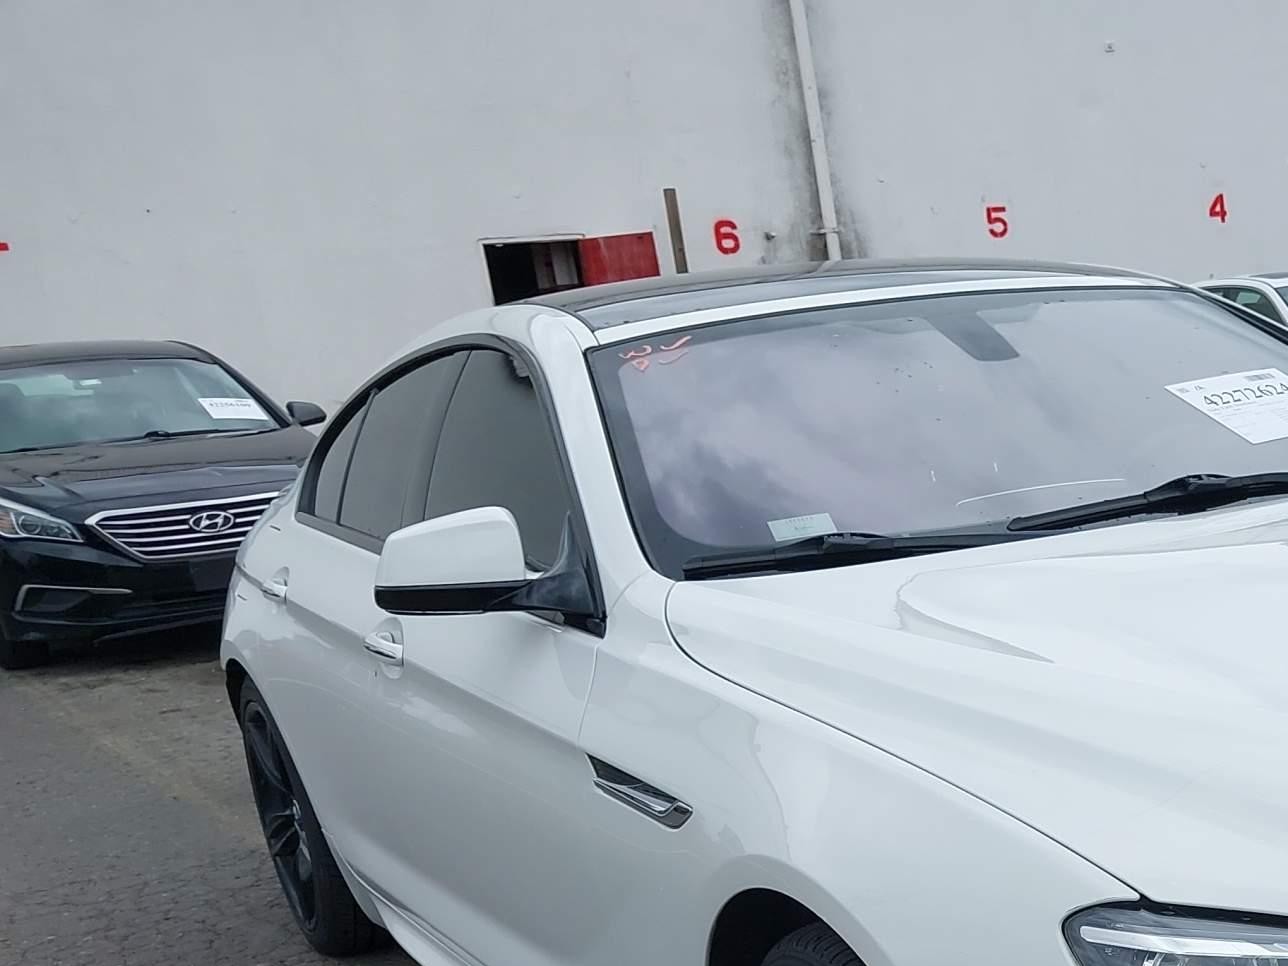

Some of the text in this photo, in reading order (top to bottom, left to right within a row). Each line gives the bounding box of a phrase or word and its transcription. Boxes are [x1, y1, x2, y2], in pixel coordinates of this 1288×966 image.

[987, 206, 1008, 238] 5
[1209, 193, 1227, 223] 4
[713, 218, 740, 255] 6
